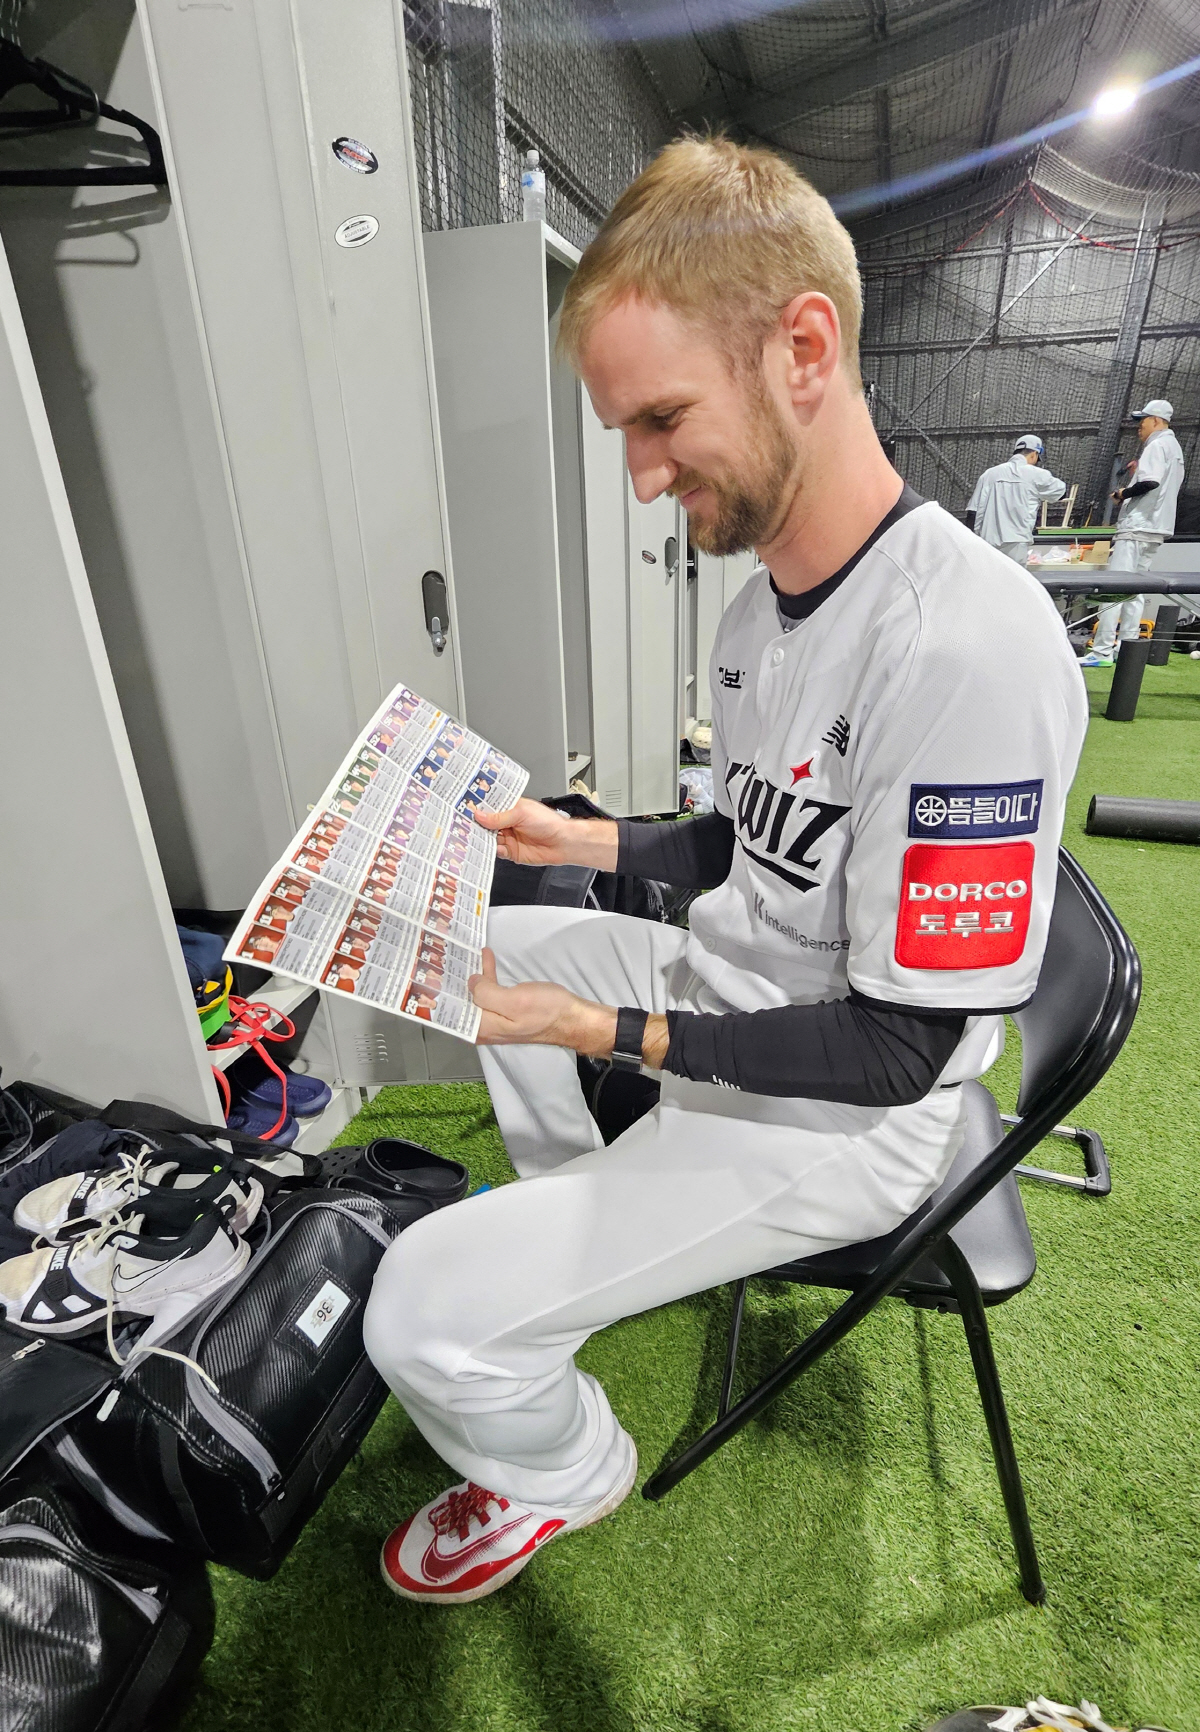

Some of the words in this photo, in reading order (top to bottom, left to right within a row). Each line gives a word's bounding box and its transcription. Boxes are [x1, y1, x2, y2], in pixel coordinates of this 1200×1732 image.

[370, 735, 380, 746] 52
[428, 750, 437, 760] 10
[457, 803, 466, 812] 33
[947, 792, 1039, 826] 뜸들이다
[295, 854, 309, 868] 36
[275, 885, 289, 899] 12
[908, 879, 1027, 903] DORCO
[259, 912, 274, 927] 11
[914, 911, 1014, 939] 도루코
[764, 909, 850, 953] intelligence
[241, 949, 254, 960] 1
[339, 941, 353, 955] 18
[325, 972, 340, 987] 15
[404, 998, 420, 1015] 29
[74, 1176, 97, 1200] NIKE
[51, 1246, 71, 1271] NIKE
[316, 1301, 333, 1322] 36
